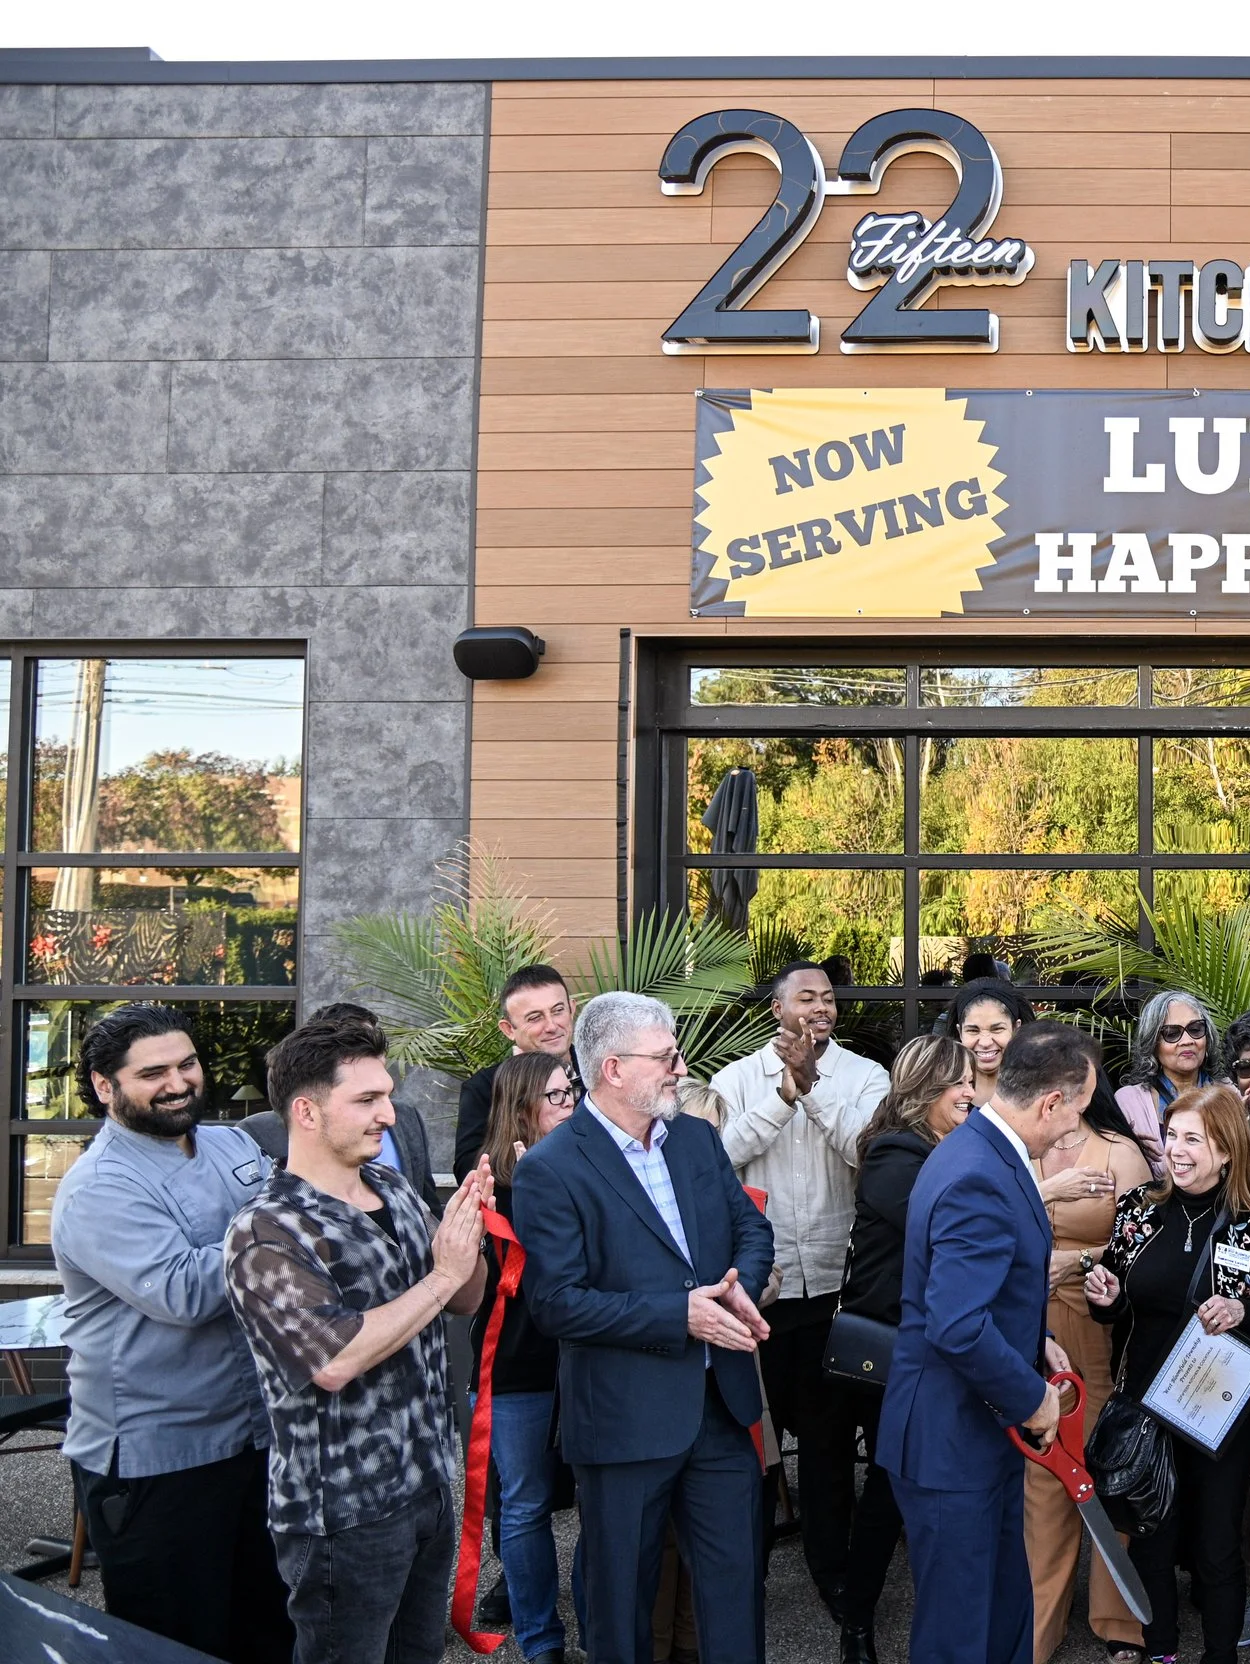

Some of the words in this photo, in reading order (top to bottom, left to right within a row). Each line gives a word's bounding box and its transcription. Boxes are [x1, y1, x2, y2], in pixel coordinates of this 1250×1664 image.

[659, 108, 1002, 350] 22
[851, 214, 1017, 284] Fifteen
[768, 424, 906, 495] NOW
[726, 477, 988, 580] SERVING
[1163, 1383, 1173, 1395] West
[1170, 1359, 1188, 1383] Bloomfield
[1185, 1337, 1202, 1360] Township
[1180, 1364, 1193, 1382] Presents
